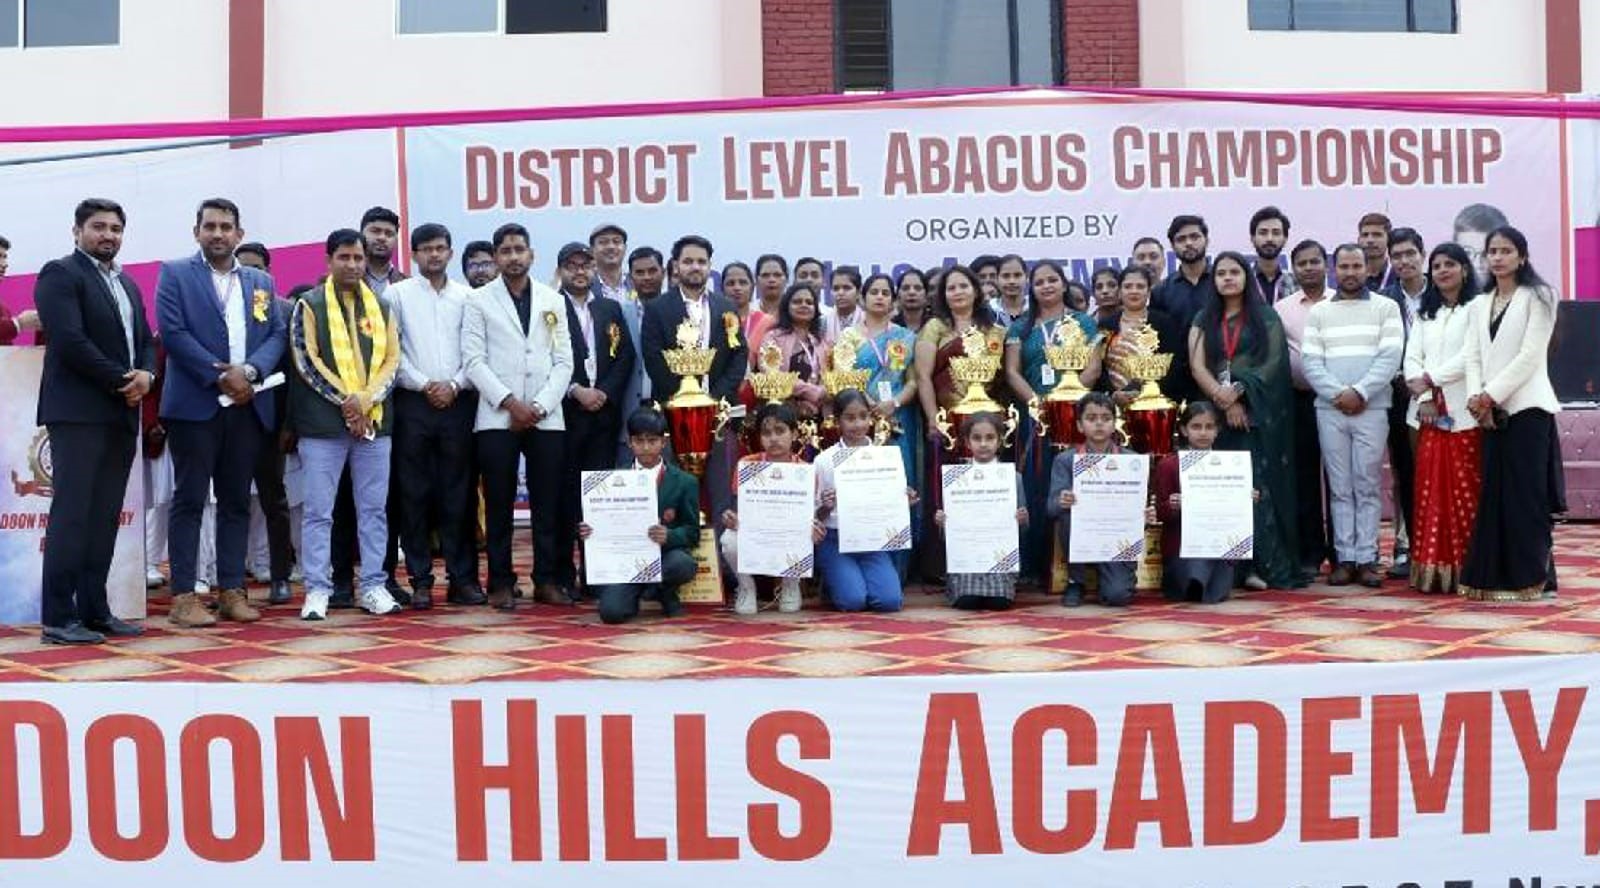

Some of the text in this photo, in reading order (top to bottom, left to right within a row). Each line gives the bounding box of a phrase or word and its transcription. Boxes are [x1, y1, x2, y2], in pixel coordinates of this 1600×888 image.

[465, 124, 1503, 210] DISTRICT LEVEL ABACUS CHAMPIONSHIP
[906, 214, 1118, 242] ORGANIZED BY
[0, 700, 375, 862] DOON
[451, 698, 832, 862] HILLS
